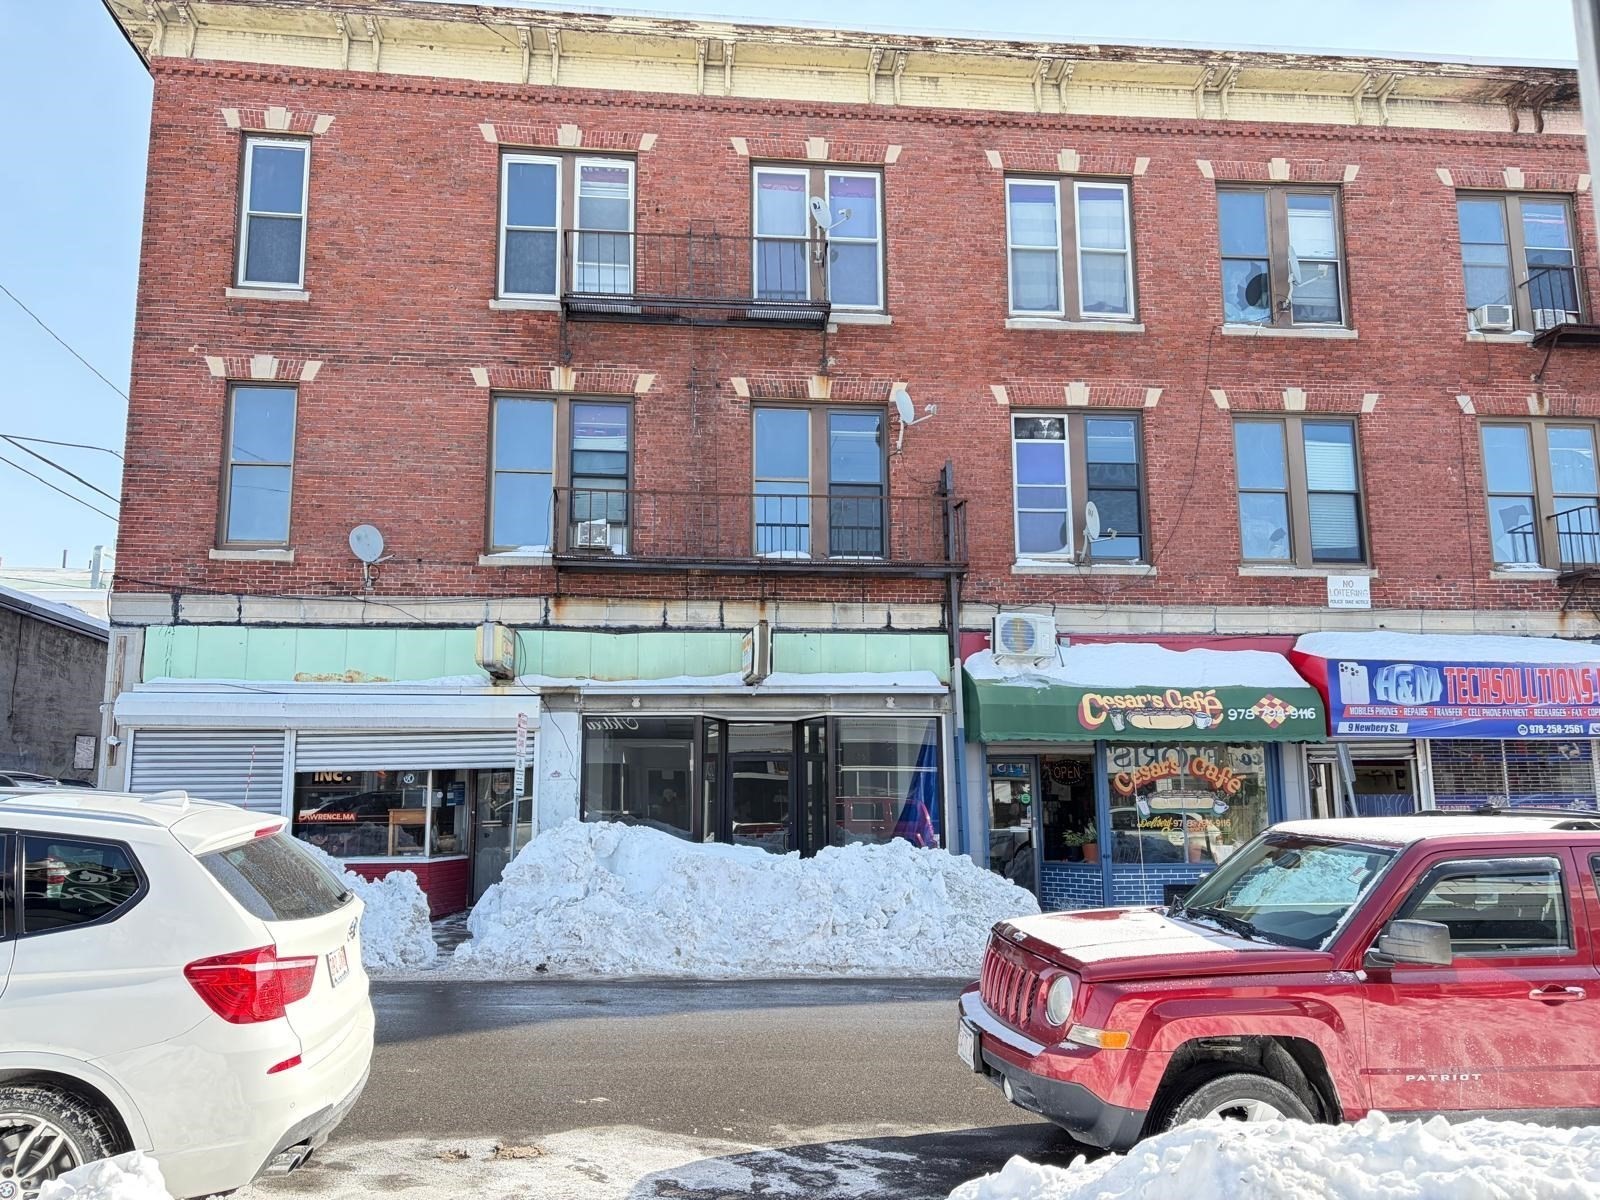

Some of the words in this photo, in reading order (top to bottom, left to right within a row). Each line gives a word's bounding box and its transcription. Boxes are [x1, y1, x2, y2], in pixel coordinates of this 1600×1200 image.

[1342, 580, 1354, 588] NO
[1329, 588, 1369, 597] LOITERING
[1375, 665, 1441, 705] H&M
[1443, 667, 1594, 705] TECHSOLUTIONS
[1079, 692, 1163, 729] Cesar's
[1165, 689, 1224, 726] Café
[1227, 707, 1316, 721] 978-794-9116
[1349, 707, 1374, 716] MOBILES
[1375, 707, 1398, 716] PHONES
[1403, 707, 1428, 716] REPAIRS
[1434, 708, 1463, 717] TRANSFER
[1468, 708, 1481, 717] CELL
[1482, 708, 1501, 717] PHONE
[1502, 708, 1528, 717] PAYMENT
[1534, 708, 1567, 717] RECHARGES
[1571, 708, 1582, 717] FAX
[1348, 723, 1353, 732] 9
[1354, 723, 1388, 733] Newbery
[1390, 723, 1400, 732] St.
[1529, 724, 1584, 734] 978-258-2561
[314, 771, 352, 782] INC.
[1053, 766, 1081, 779] OPEN
[1188, 756, 1247, 796] Café
[1405, 1073, 1482, 1082] PATRIOT
